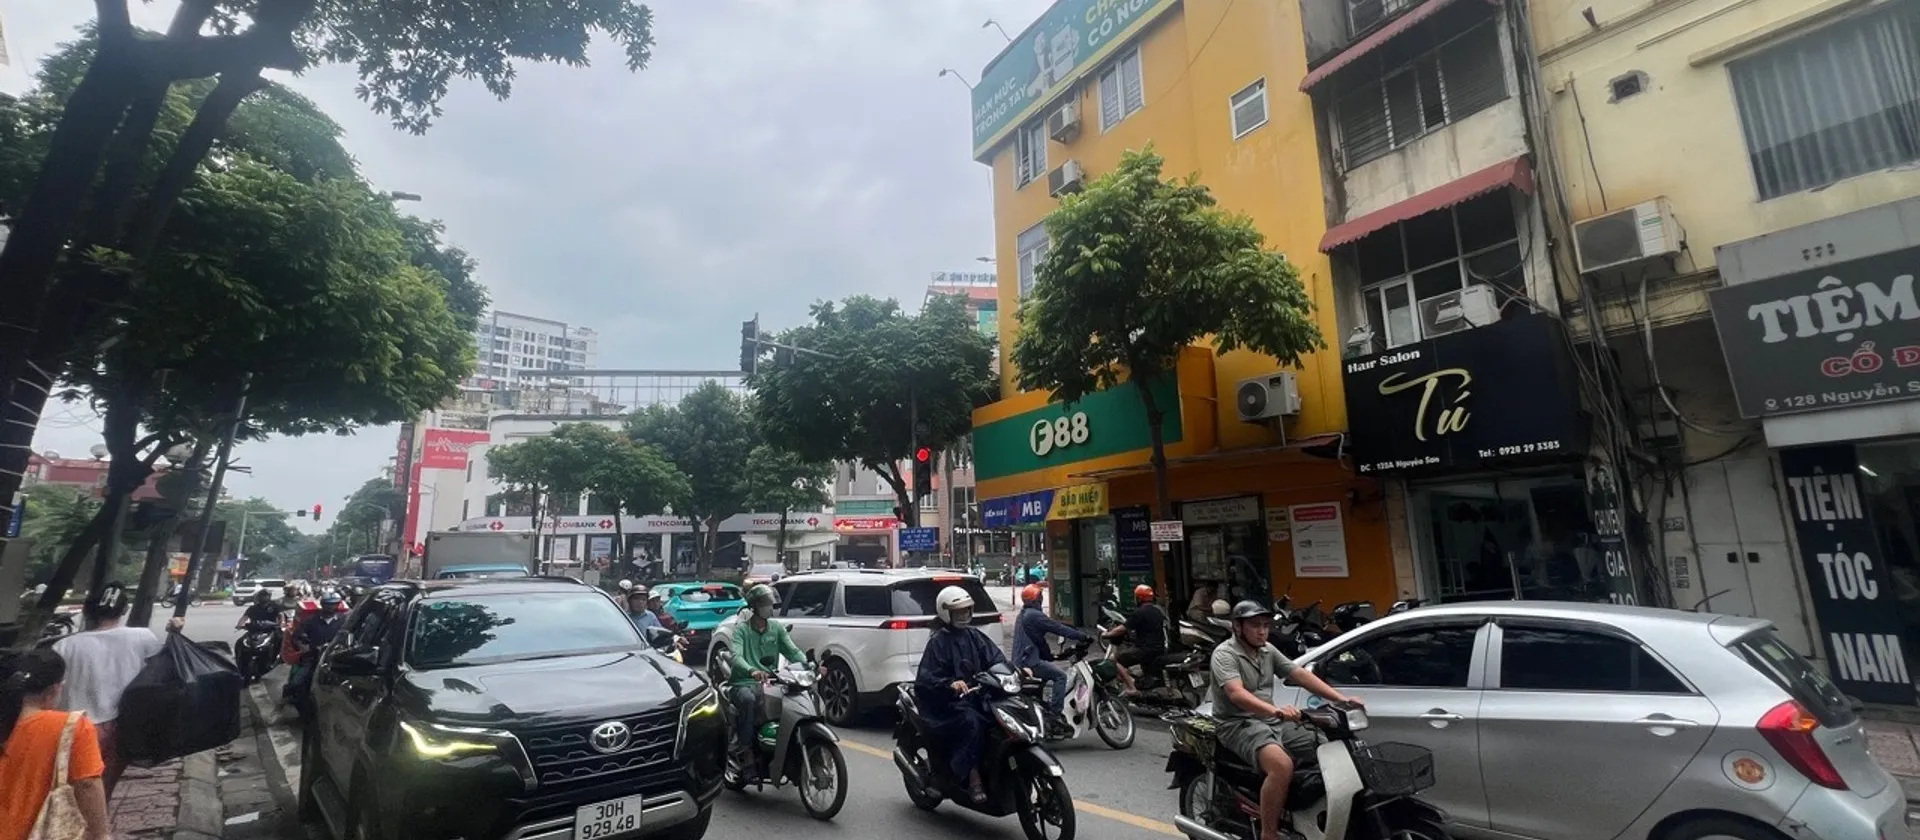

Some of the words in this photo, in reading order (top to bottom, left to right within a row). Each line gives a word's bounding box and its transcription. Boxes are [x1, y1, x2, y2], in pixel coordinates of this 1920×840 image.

[1087, 13, 1113, 47] CÓ
[1117, 0, 1149, 25] NG
[1008, 83, 1028, 108] TAY
[1748, 274, 1920, 344] TIỆM
[1347, 360, 1377, 374] Hair
[1379, 350, 1421, 366] Salon
[1821, 340, 1883, 377] CỔ
[1378, 367, 1472, 442] Tú
[1783, 394, 1816, 408] 128
[1030, 411, 1089, 456] F88
[1021, 500, 1043, 518] MB
[1788, 465, 1863, 531] TIỆM
[1604, 550, 1628, 578] GIA
[1816, 542, 1879, 600] TÓC
[1830, 632, 1911, 684] NAM
[582, 815, 634, 839] 929.48
[595, 801, 624, 820] 30H
